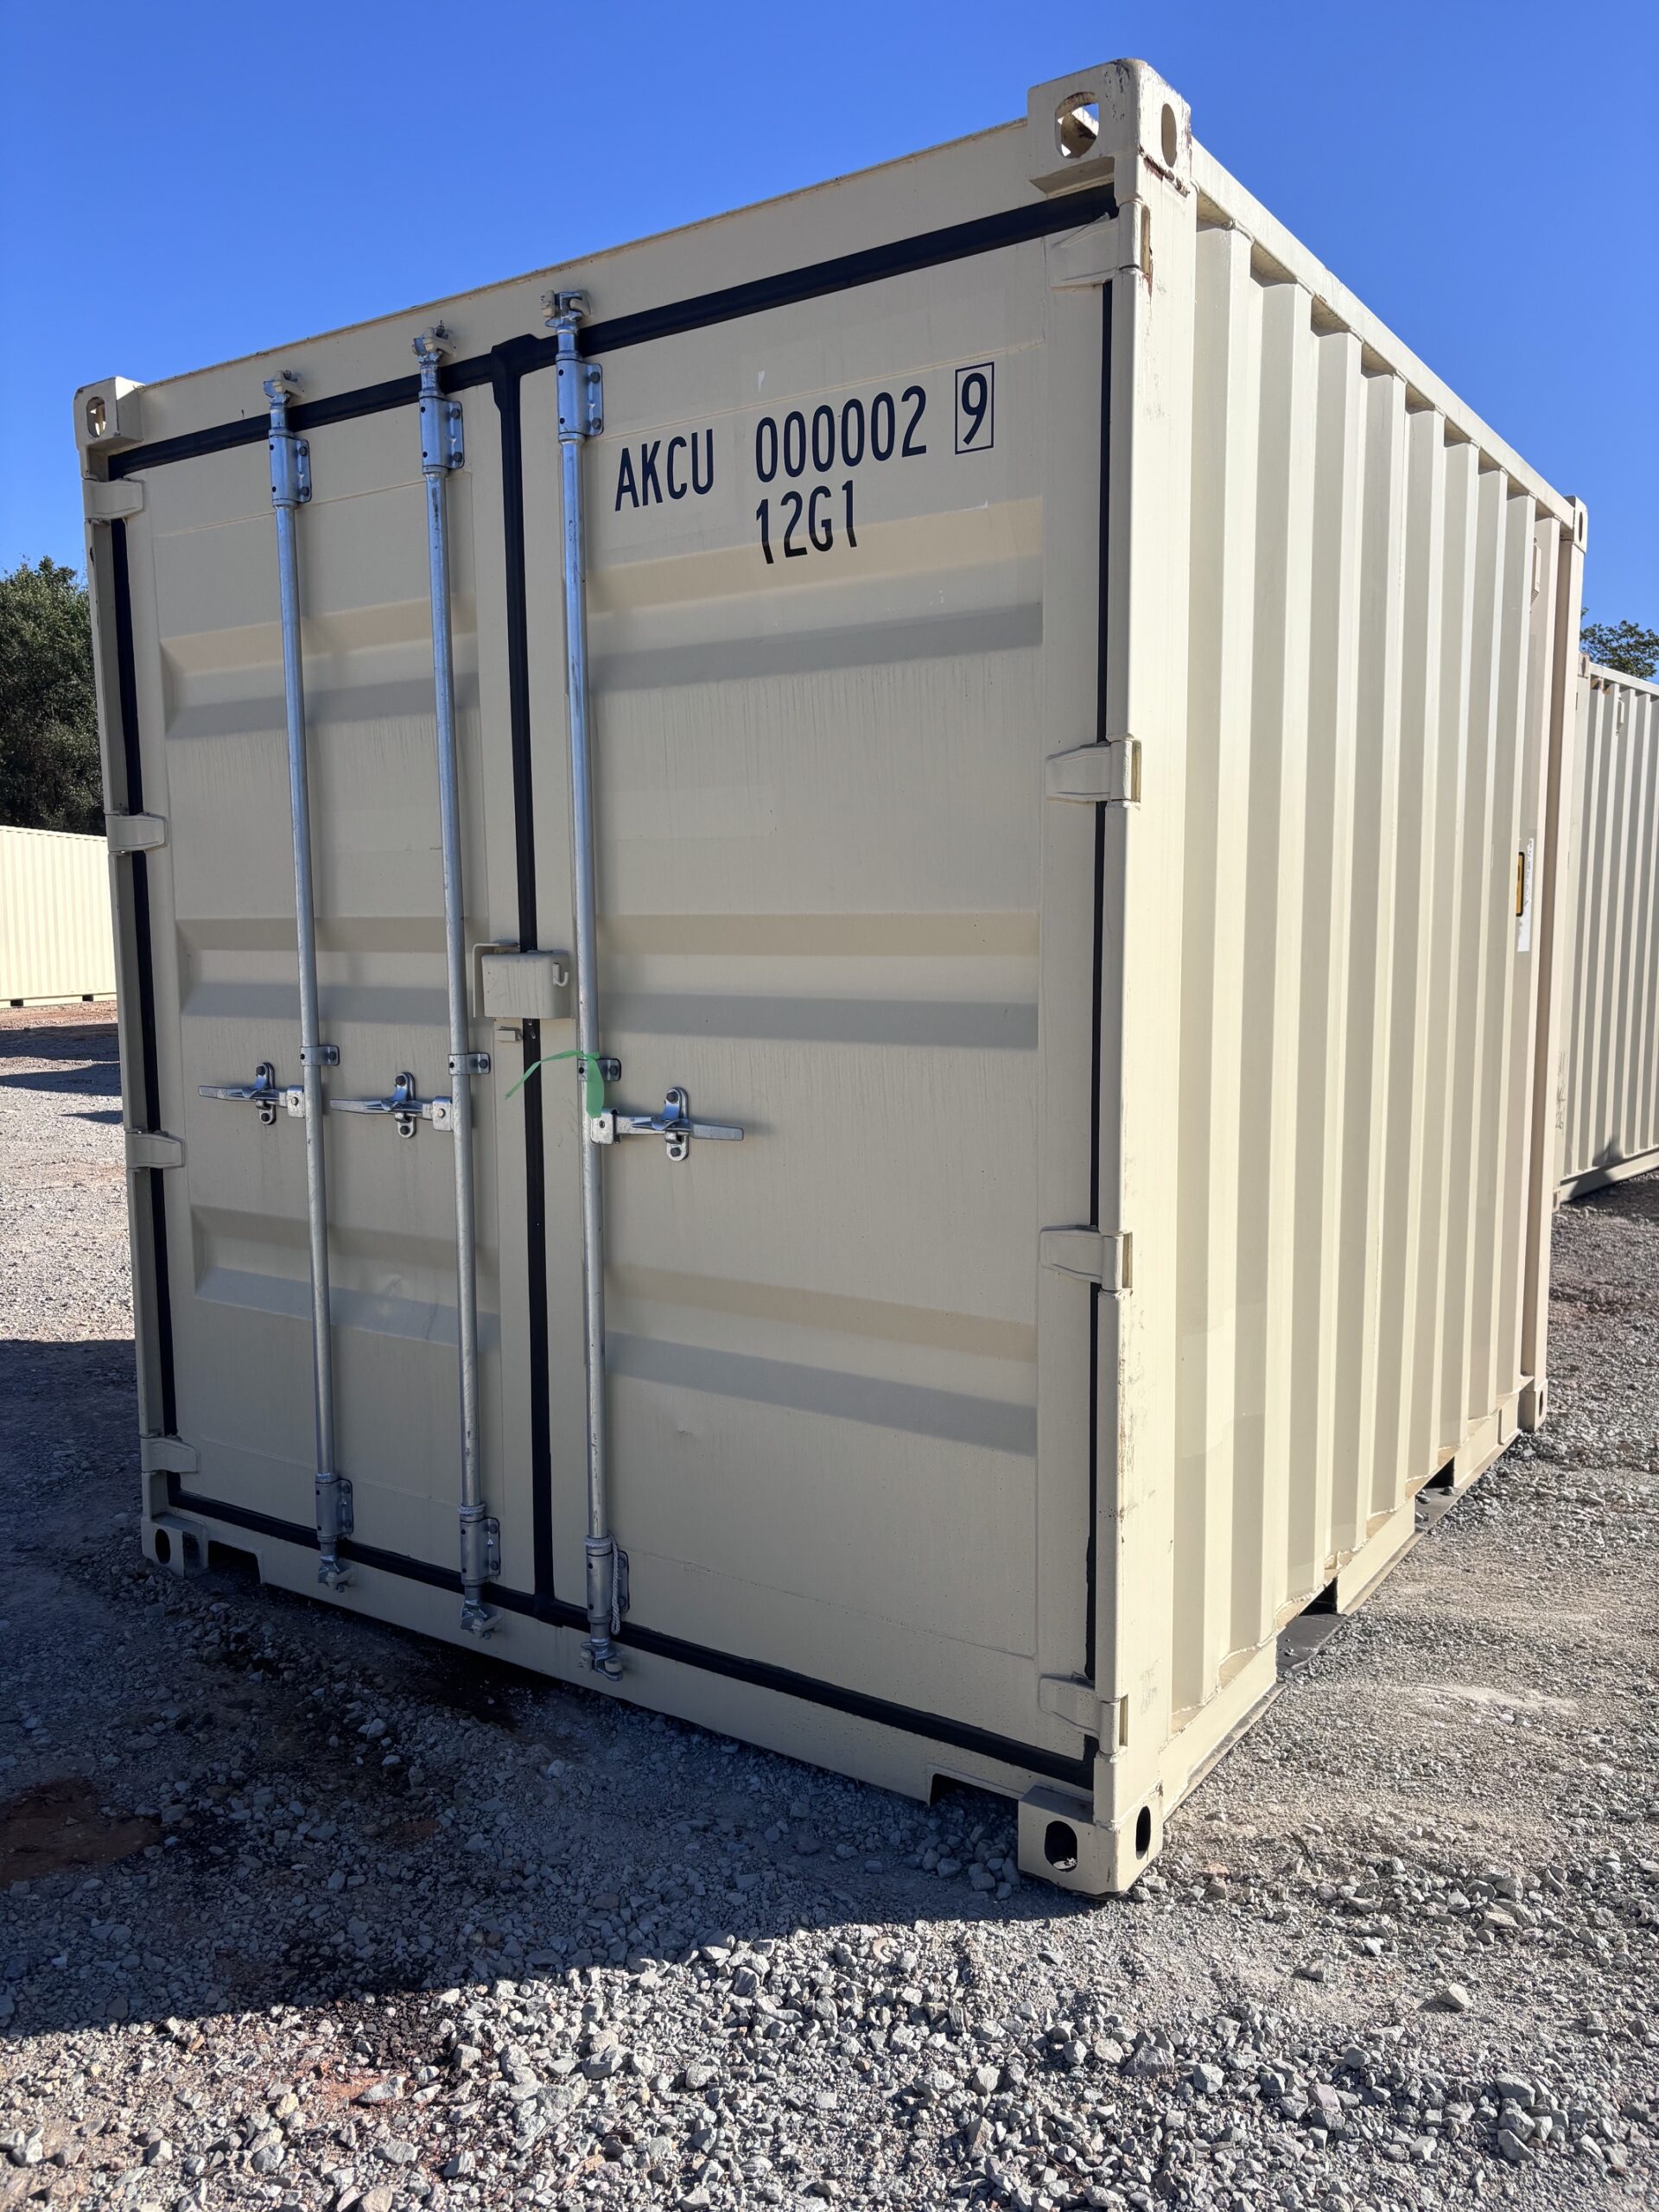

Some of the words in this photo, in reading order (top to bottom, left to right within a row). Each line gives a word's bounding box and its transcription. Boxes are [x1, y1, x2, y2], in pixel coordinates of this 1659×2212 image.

[613, 428, 715, 512] AKCU
[754, 385, 928, 484] 000002
[960, 372, 988, 446] 9
[754, 479, 859, 566] 12G1
